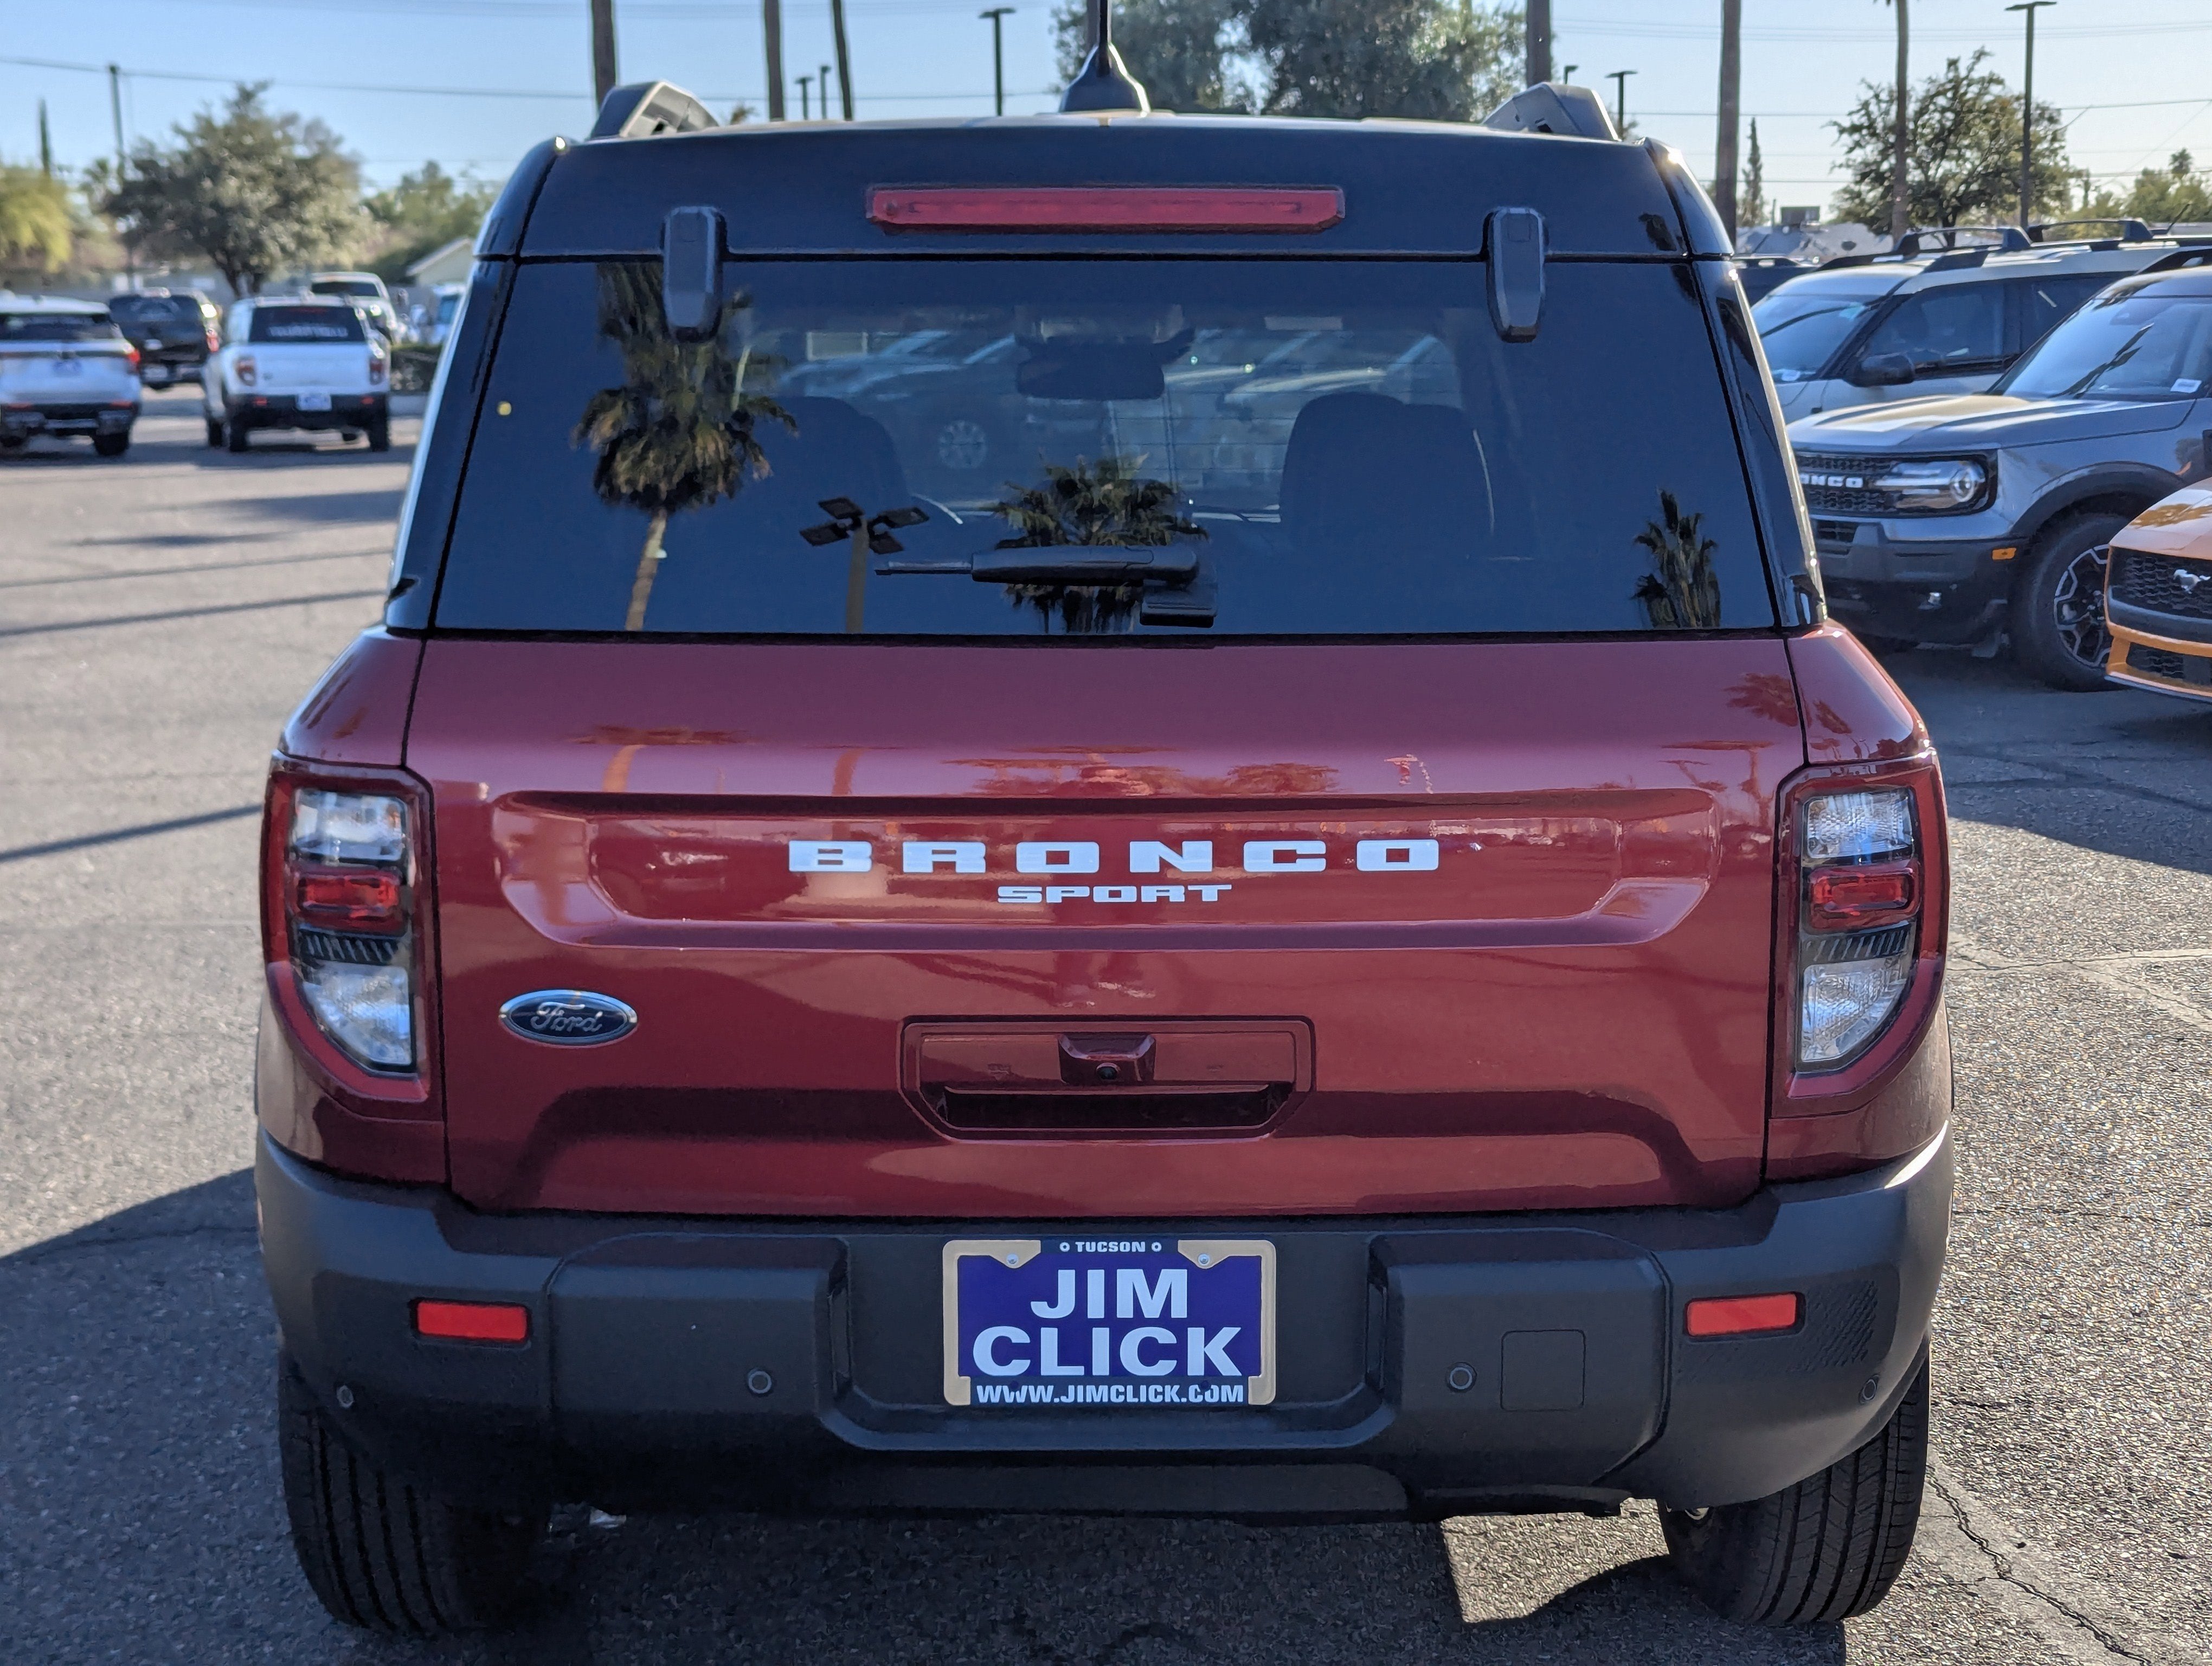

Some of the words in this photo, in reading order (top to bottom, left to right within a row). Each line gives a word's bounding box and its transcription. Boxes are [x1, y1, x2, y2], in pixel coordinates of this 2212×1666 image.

[789, 840, 1439, 873] BRONCO
[998, 885, 1231, 902] SPORT
[530, 1001, 603, 1031] Ford
[1075, 1241, 1146, 1252] TUCSON
[1030, 1269, 1188, 1318] JIM
[973, 1325, 1242, 1376] CLICK
[976, 1385, 1243, 1403] WWW.JIMCLICK.COM
